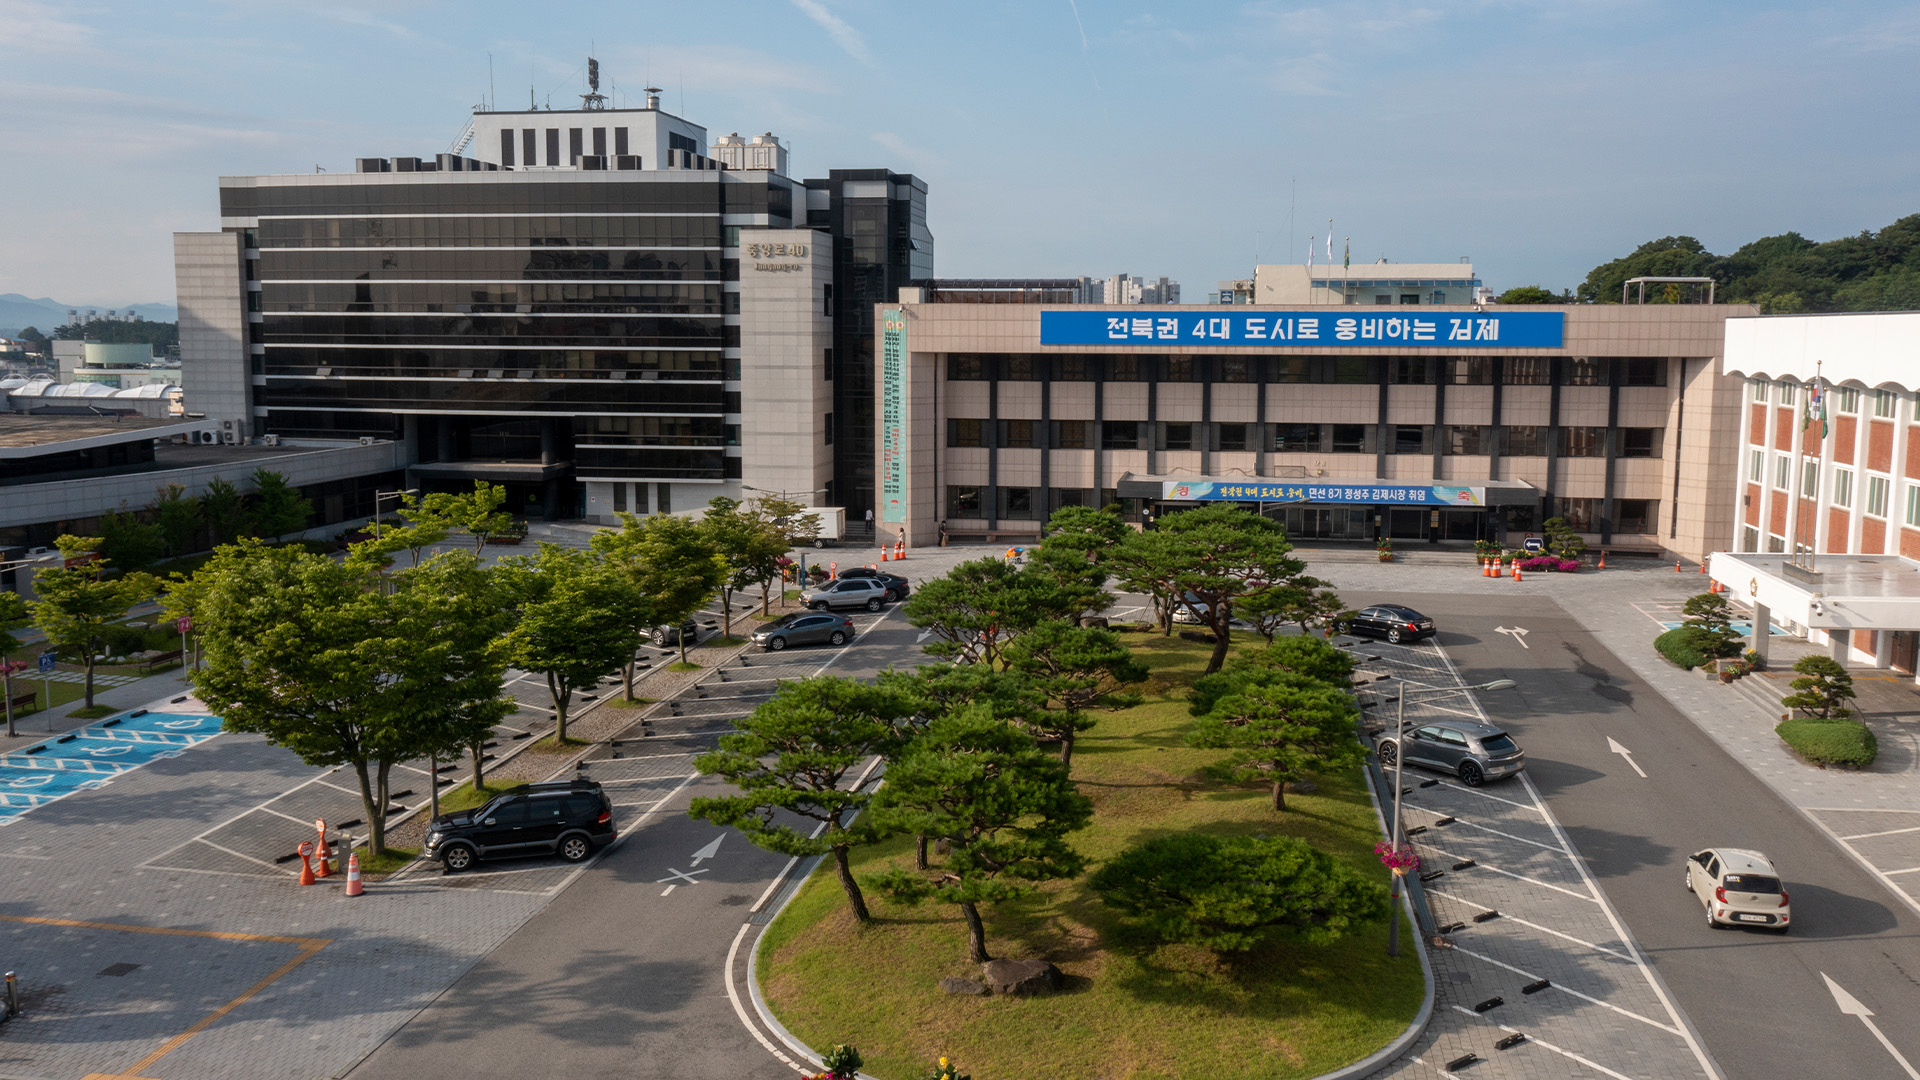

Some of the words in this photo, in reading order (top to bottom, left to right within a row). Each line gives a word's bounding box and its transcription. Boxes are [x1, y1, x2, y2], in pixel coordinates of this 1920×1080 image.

[747, 242, 786, 258] 중앙로
[787, 243, 805, 257] 40
[1107, 317, 1179, 339] 전북권
[1192, 318, 1231, 340] 4대
[1244, 318, 1320, 340] 도시로
[1334, 317, 1436, 341] 웅비하는
[1448, 318, 1500, 341] 김제
[1177, 485, 1189, 497] 경
[1245, 486, 1258, 498] 4대
[1260, 487, 1284, 498] 도시로
[1308, 487, 1326, 499] 민선
[1328, 488, 1342, 499] 8기
[1344, 488, 1370, 500] 정성주
[1372, 488, 1407, 501] 김제시장
[1457, 490, 1470, 502] 축
